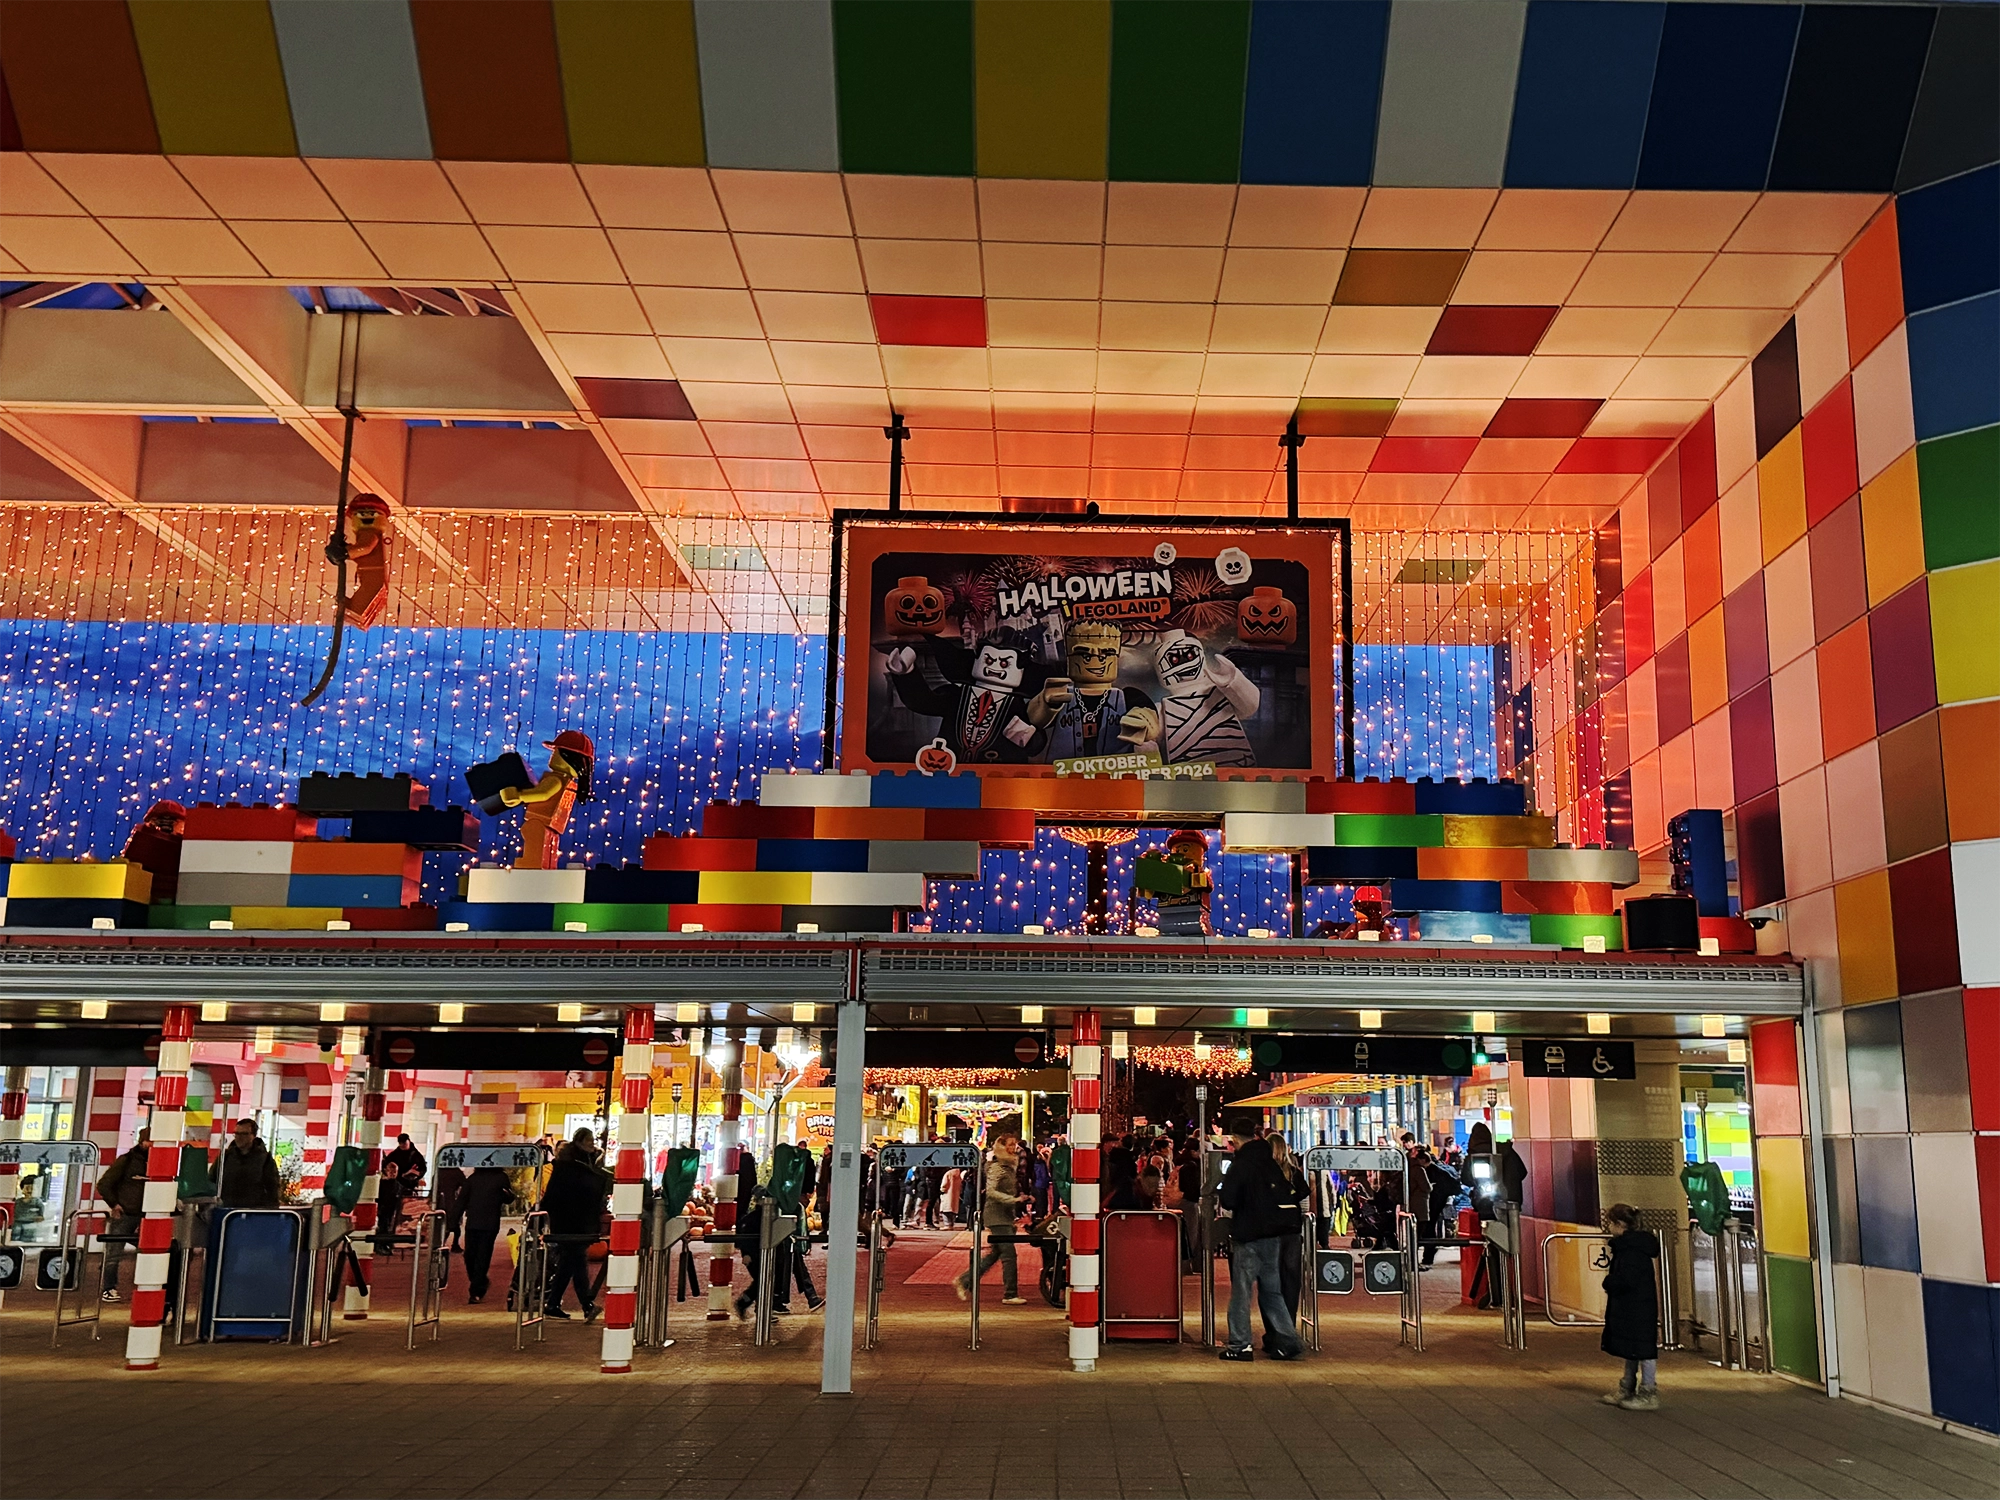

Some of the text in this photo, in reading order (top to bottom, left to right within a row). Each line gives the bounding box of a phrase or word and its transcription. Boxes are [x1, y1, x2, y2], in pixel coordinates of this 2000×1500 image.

[998, 569, 1172, 616] HALLOWEEN
[1075, 600, 1162, 619] LEGOLAND
[1056, 762, 1071, 775] 2.
[1073, 755, 1148, 773] OKTOBER
[1174, 764, 1212, 779] 2026
